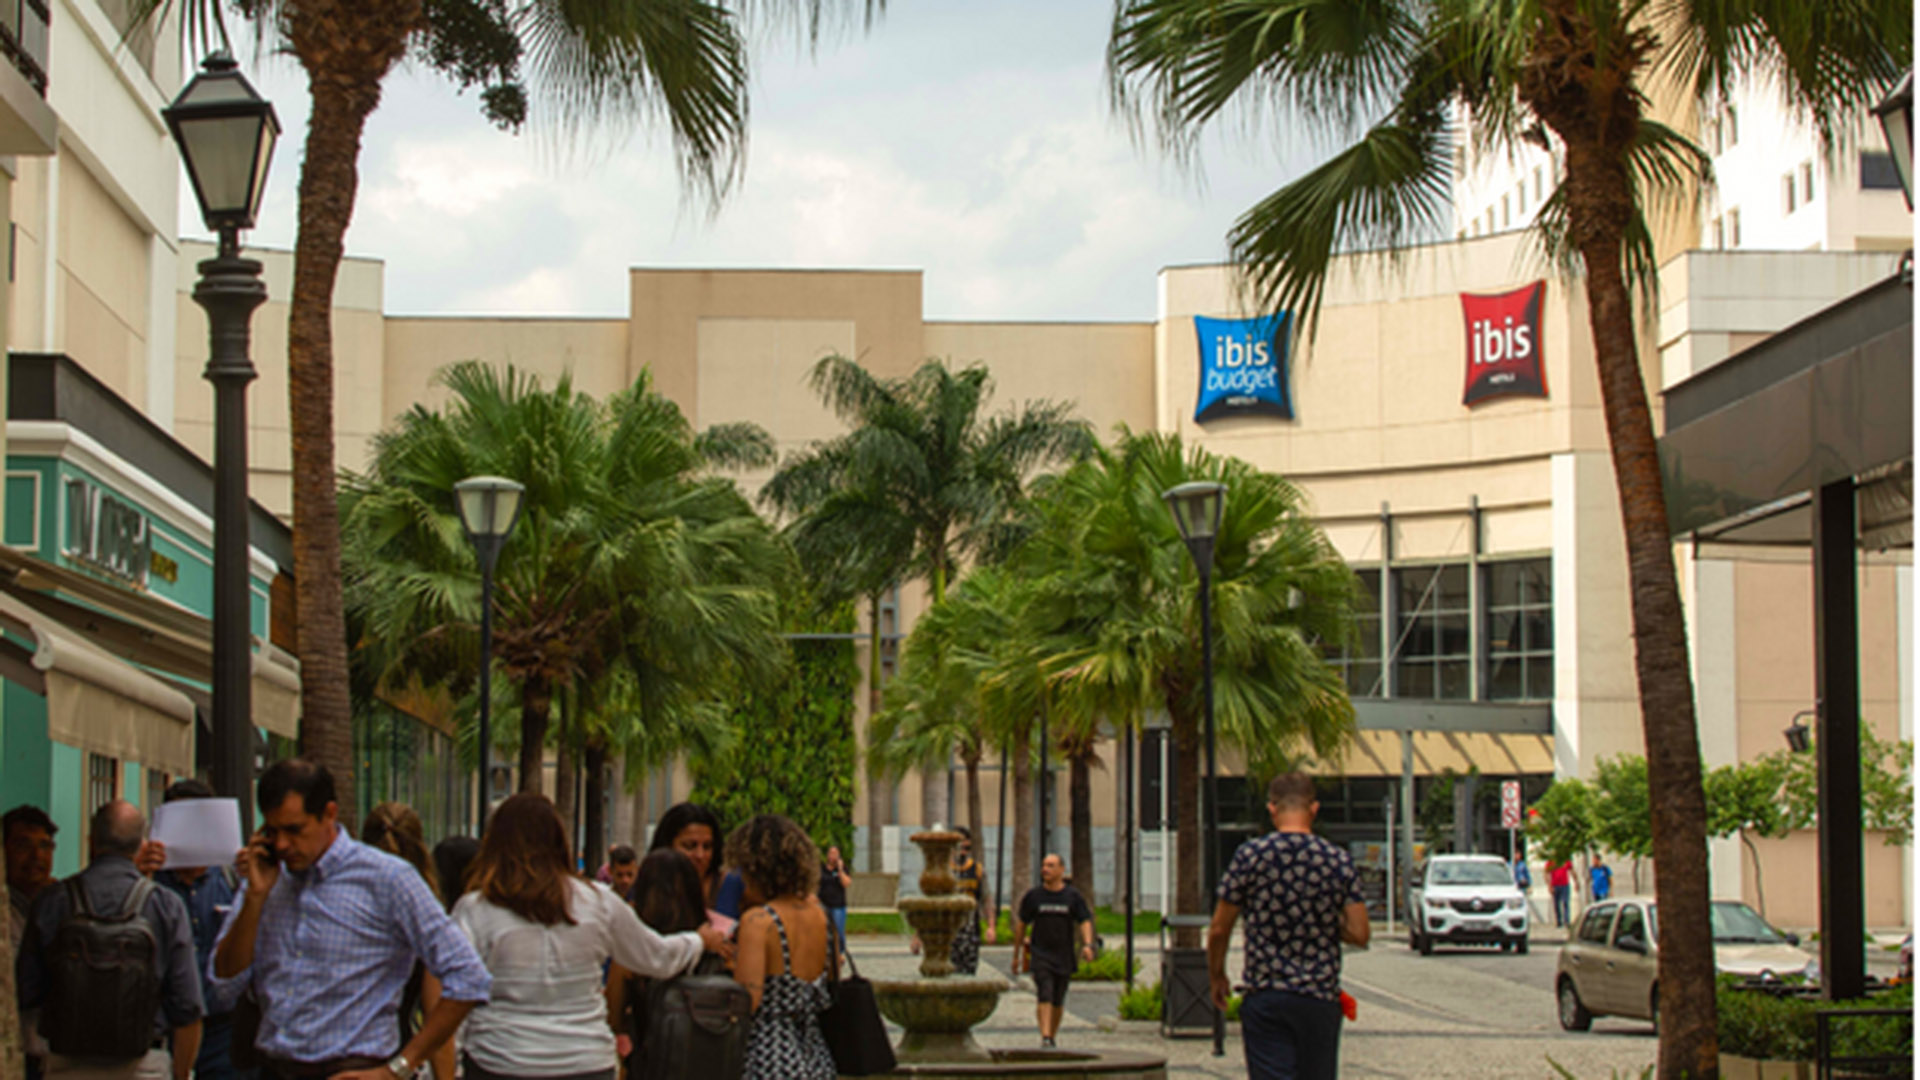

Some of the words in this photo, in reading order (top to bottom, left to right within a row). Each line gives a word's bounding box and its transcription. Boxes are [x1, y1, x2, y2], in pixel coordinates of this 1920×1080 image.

[1216, 334, 1269, 367] ibis
[1474, 317, 1531, 364] ibis
[1207, 366, 1277, 394] budget
